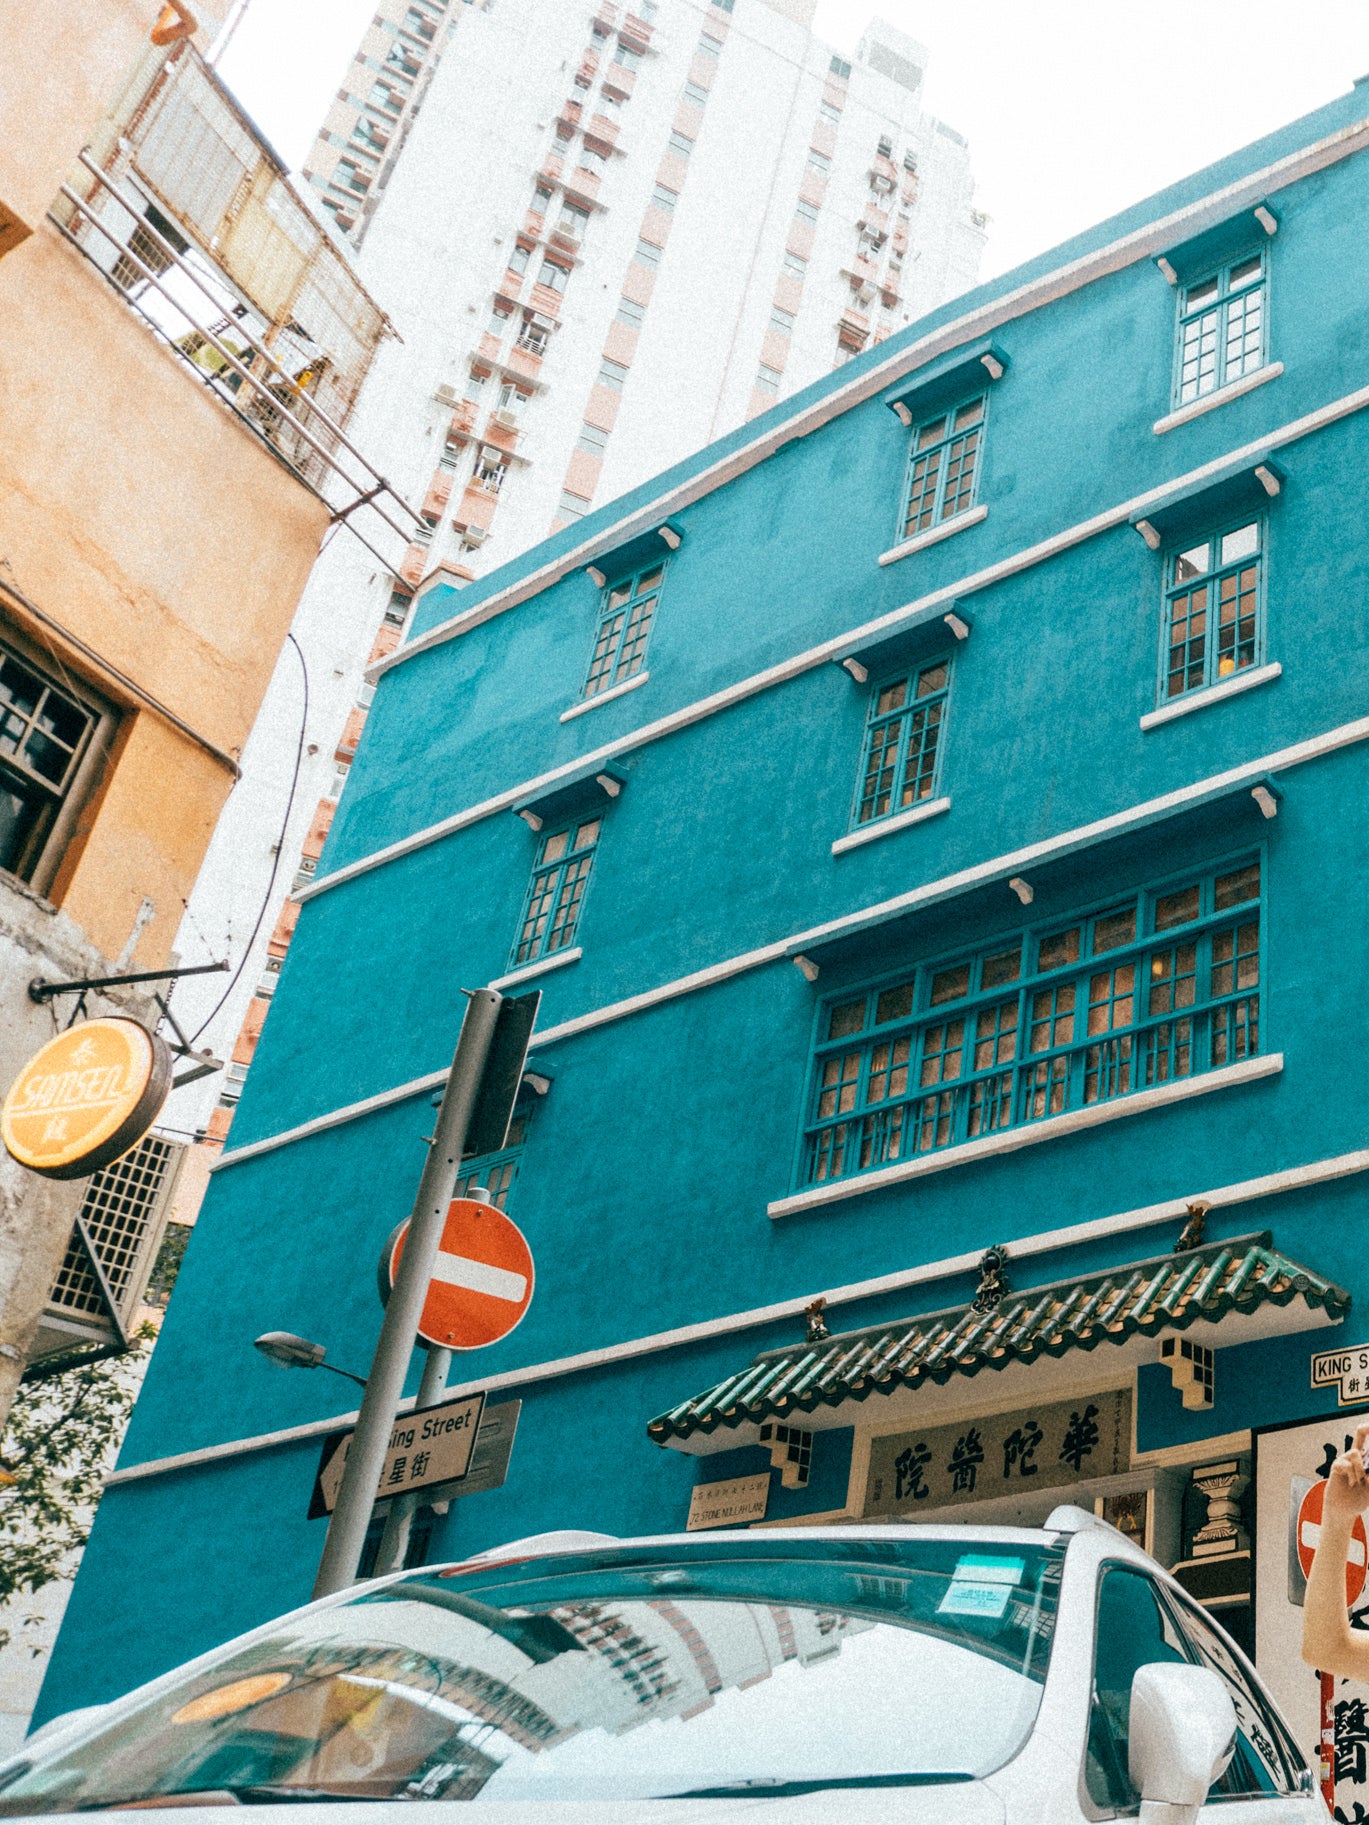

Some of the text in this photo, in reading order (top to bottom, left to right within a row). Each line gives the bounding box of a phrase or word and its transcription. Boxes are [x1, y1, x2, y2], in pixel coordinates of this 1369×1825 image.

[10, 1064, 131, 1111] SAMSEN
[1318, 1357, 1351, 1377] KING
[421, 1408, 472, 1439] Street
[701, 1509, 721, 1520] STONE
[722, 1504, 747, 1517] NULLAH
[748, 1501, 764, 1514] LANE
